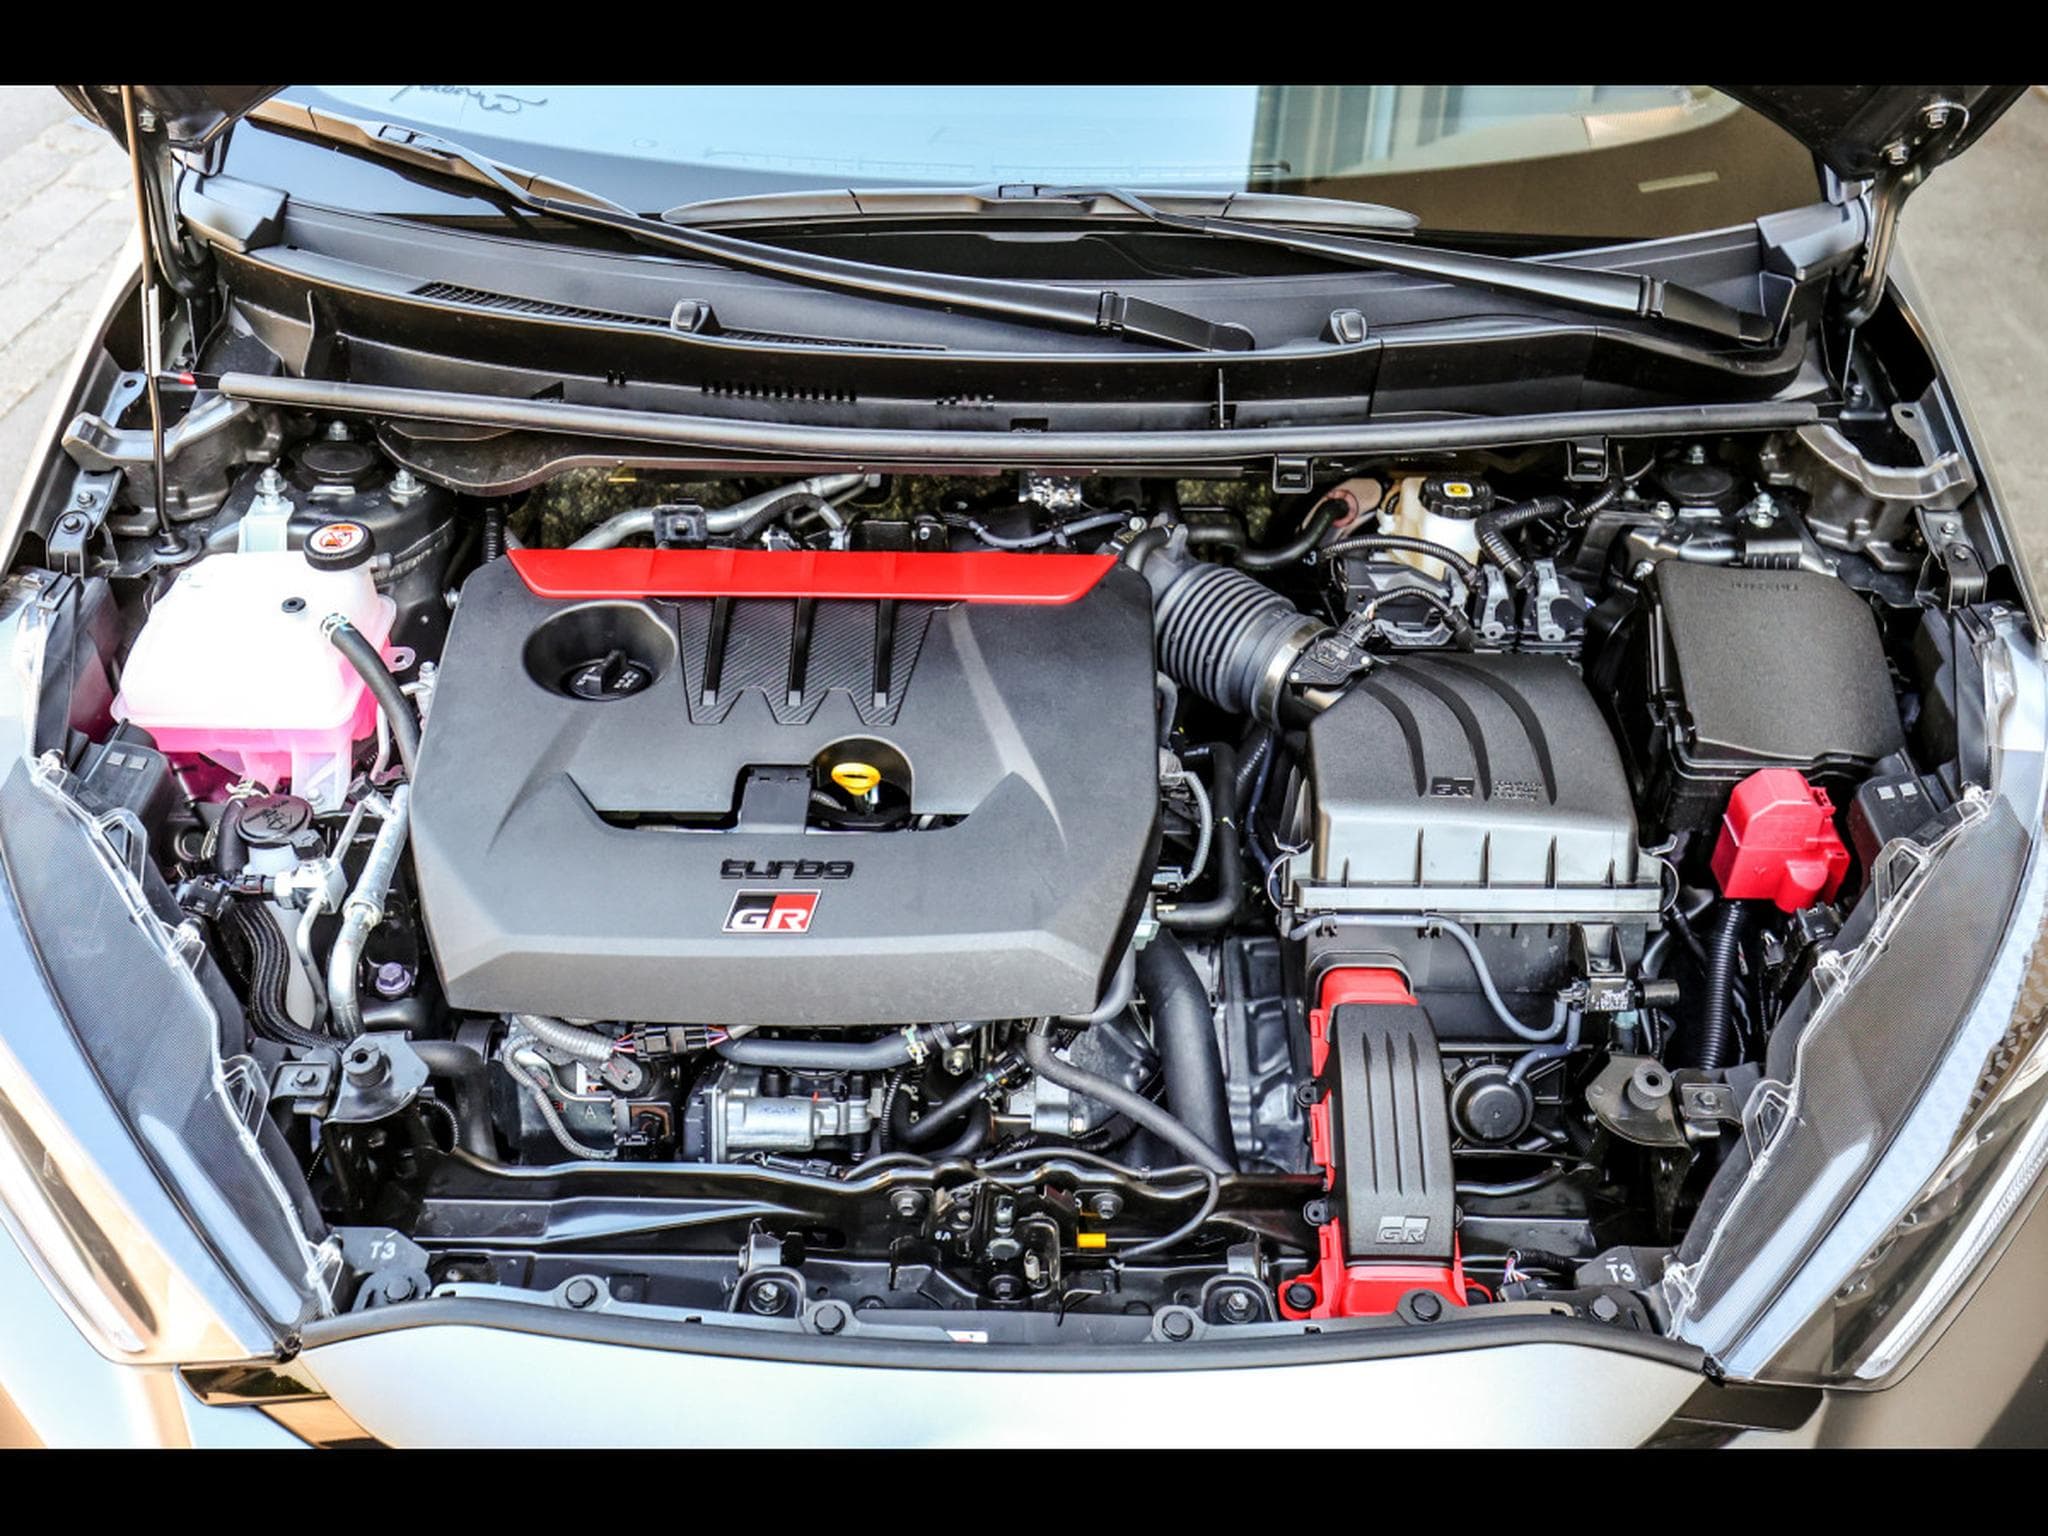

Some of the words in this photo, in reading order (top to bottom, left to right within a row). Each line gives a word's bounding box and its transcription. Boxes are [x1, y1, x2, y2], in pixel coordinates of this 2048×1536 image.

[720, 858, 854, 880] turbo
[728, 905, 811, 931] GR
[1378, 1225, 1428, 1244] GR
[370, 1241, 396, 1260] T3
[1605, 1264, 1636, 1283] T3
